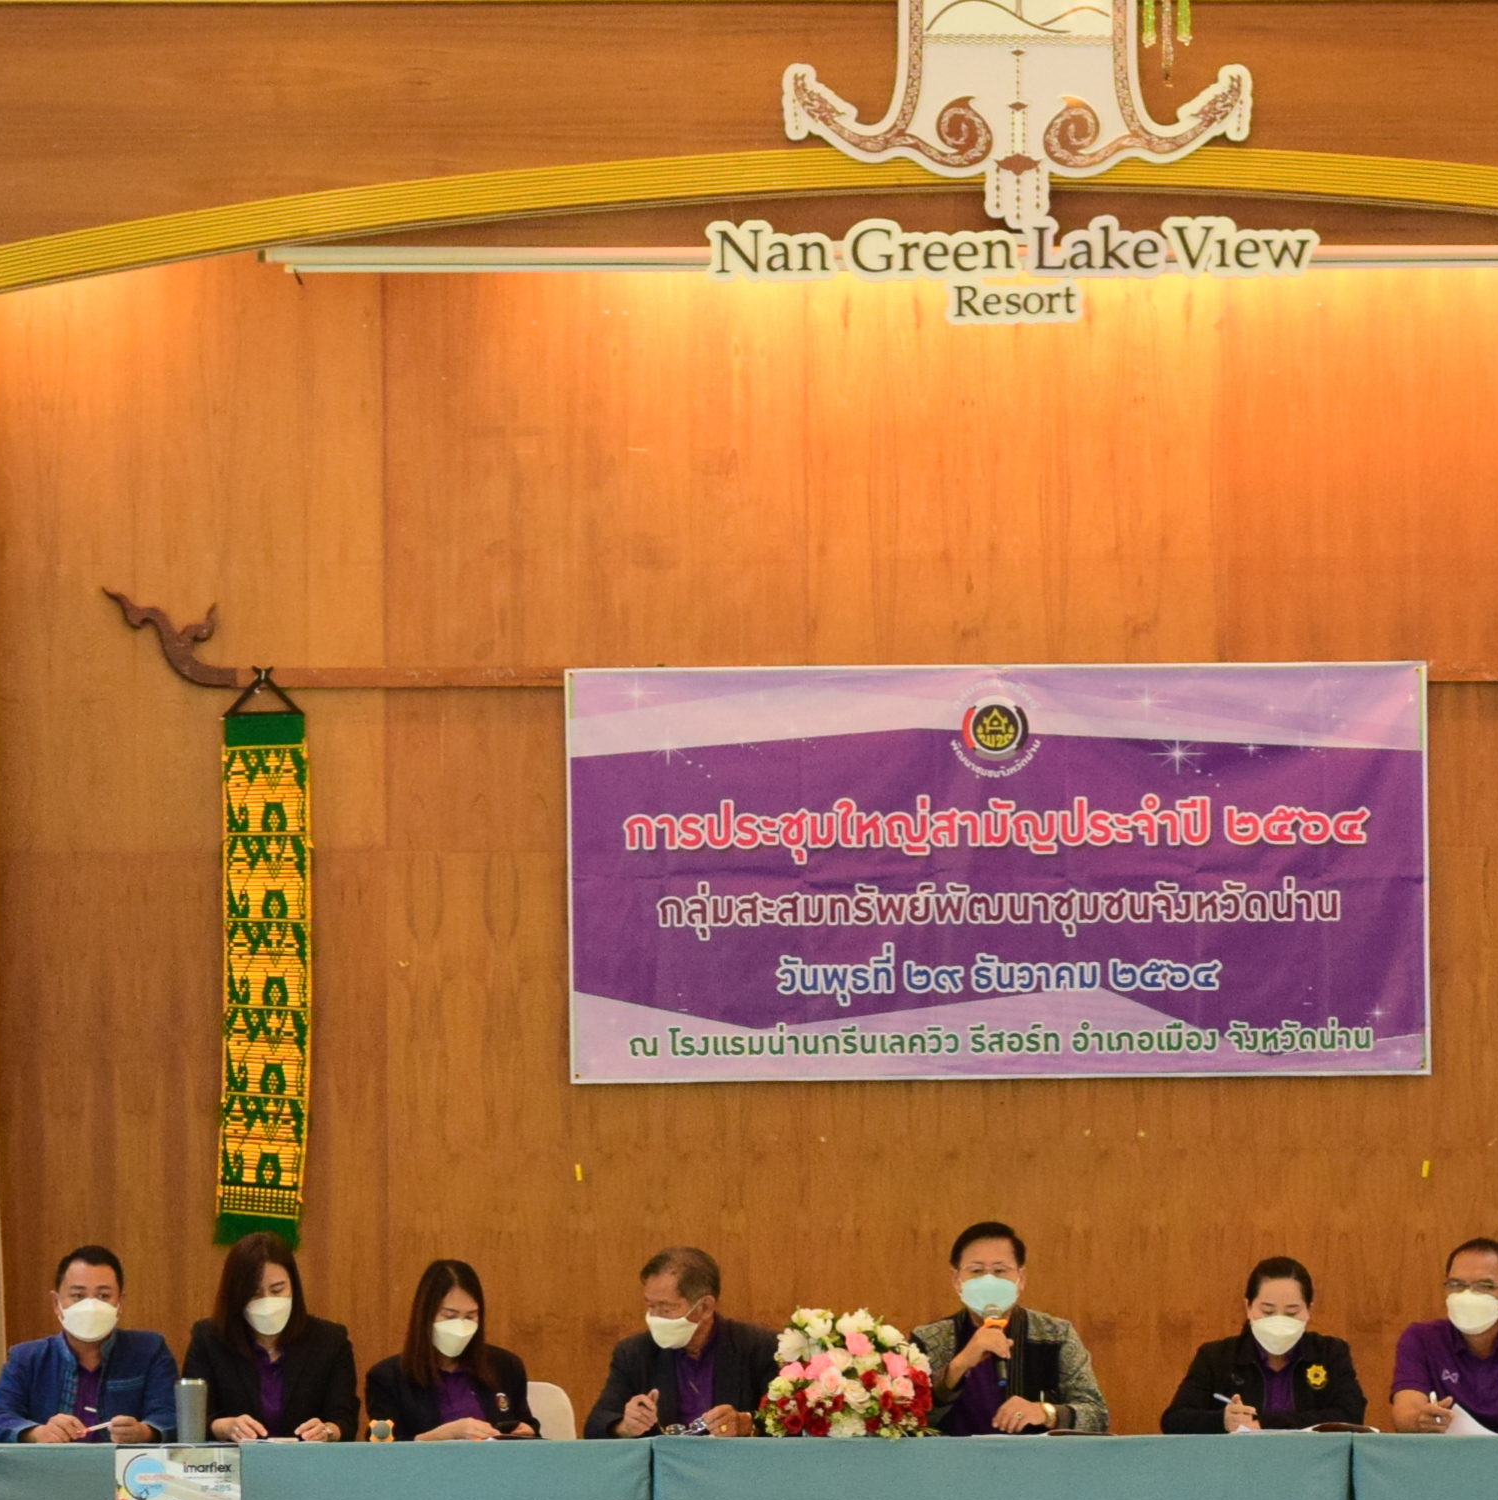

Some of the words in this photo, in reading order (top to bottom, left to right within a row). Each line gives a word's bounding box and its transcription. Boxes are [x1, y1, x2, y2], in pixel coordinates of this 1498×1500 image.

[714, 227, 829, 273] Nan
[850, 226, 1014, 273] Green
[1032, 225, 1160, 271] Lake
[1169, 223, 1312, 270] View
[953, 283, 1076, 317] Resort
[623, 793, 1211, 865] การประชุมใหญ่สามัญประจำปี
[1223, 804, 1372, 848] ๒๕๖๔
[656, 876, 1342, 941] กลุ่มสะสมทรัพย์พัฒนาชุมชนจังหวัดน่าน
[776, 942, 896, 1007] วันพุธที่
[903, 960, 964, 994] ๒๙
[971, 952, 1100, 994] ธันวาคม
[1109, 959, 1222, 992] ๒๕๖๔
[628, 1033, 659, 1058] ณ
[668, 1021, 961, 1058] โรงแรมน่านกรีนเลควิว
[970, 1021, 1062, 1055] รีสอร์ท
[1070, 1020, 1219, 1055] อำเภอเมือง
[1227, 1016, 1374, 1054] จังหวัดน่าน
[183, 1461, 232, 1474] imarflex
